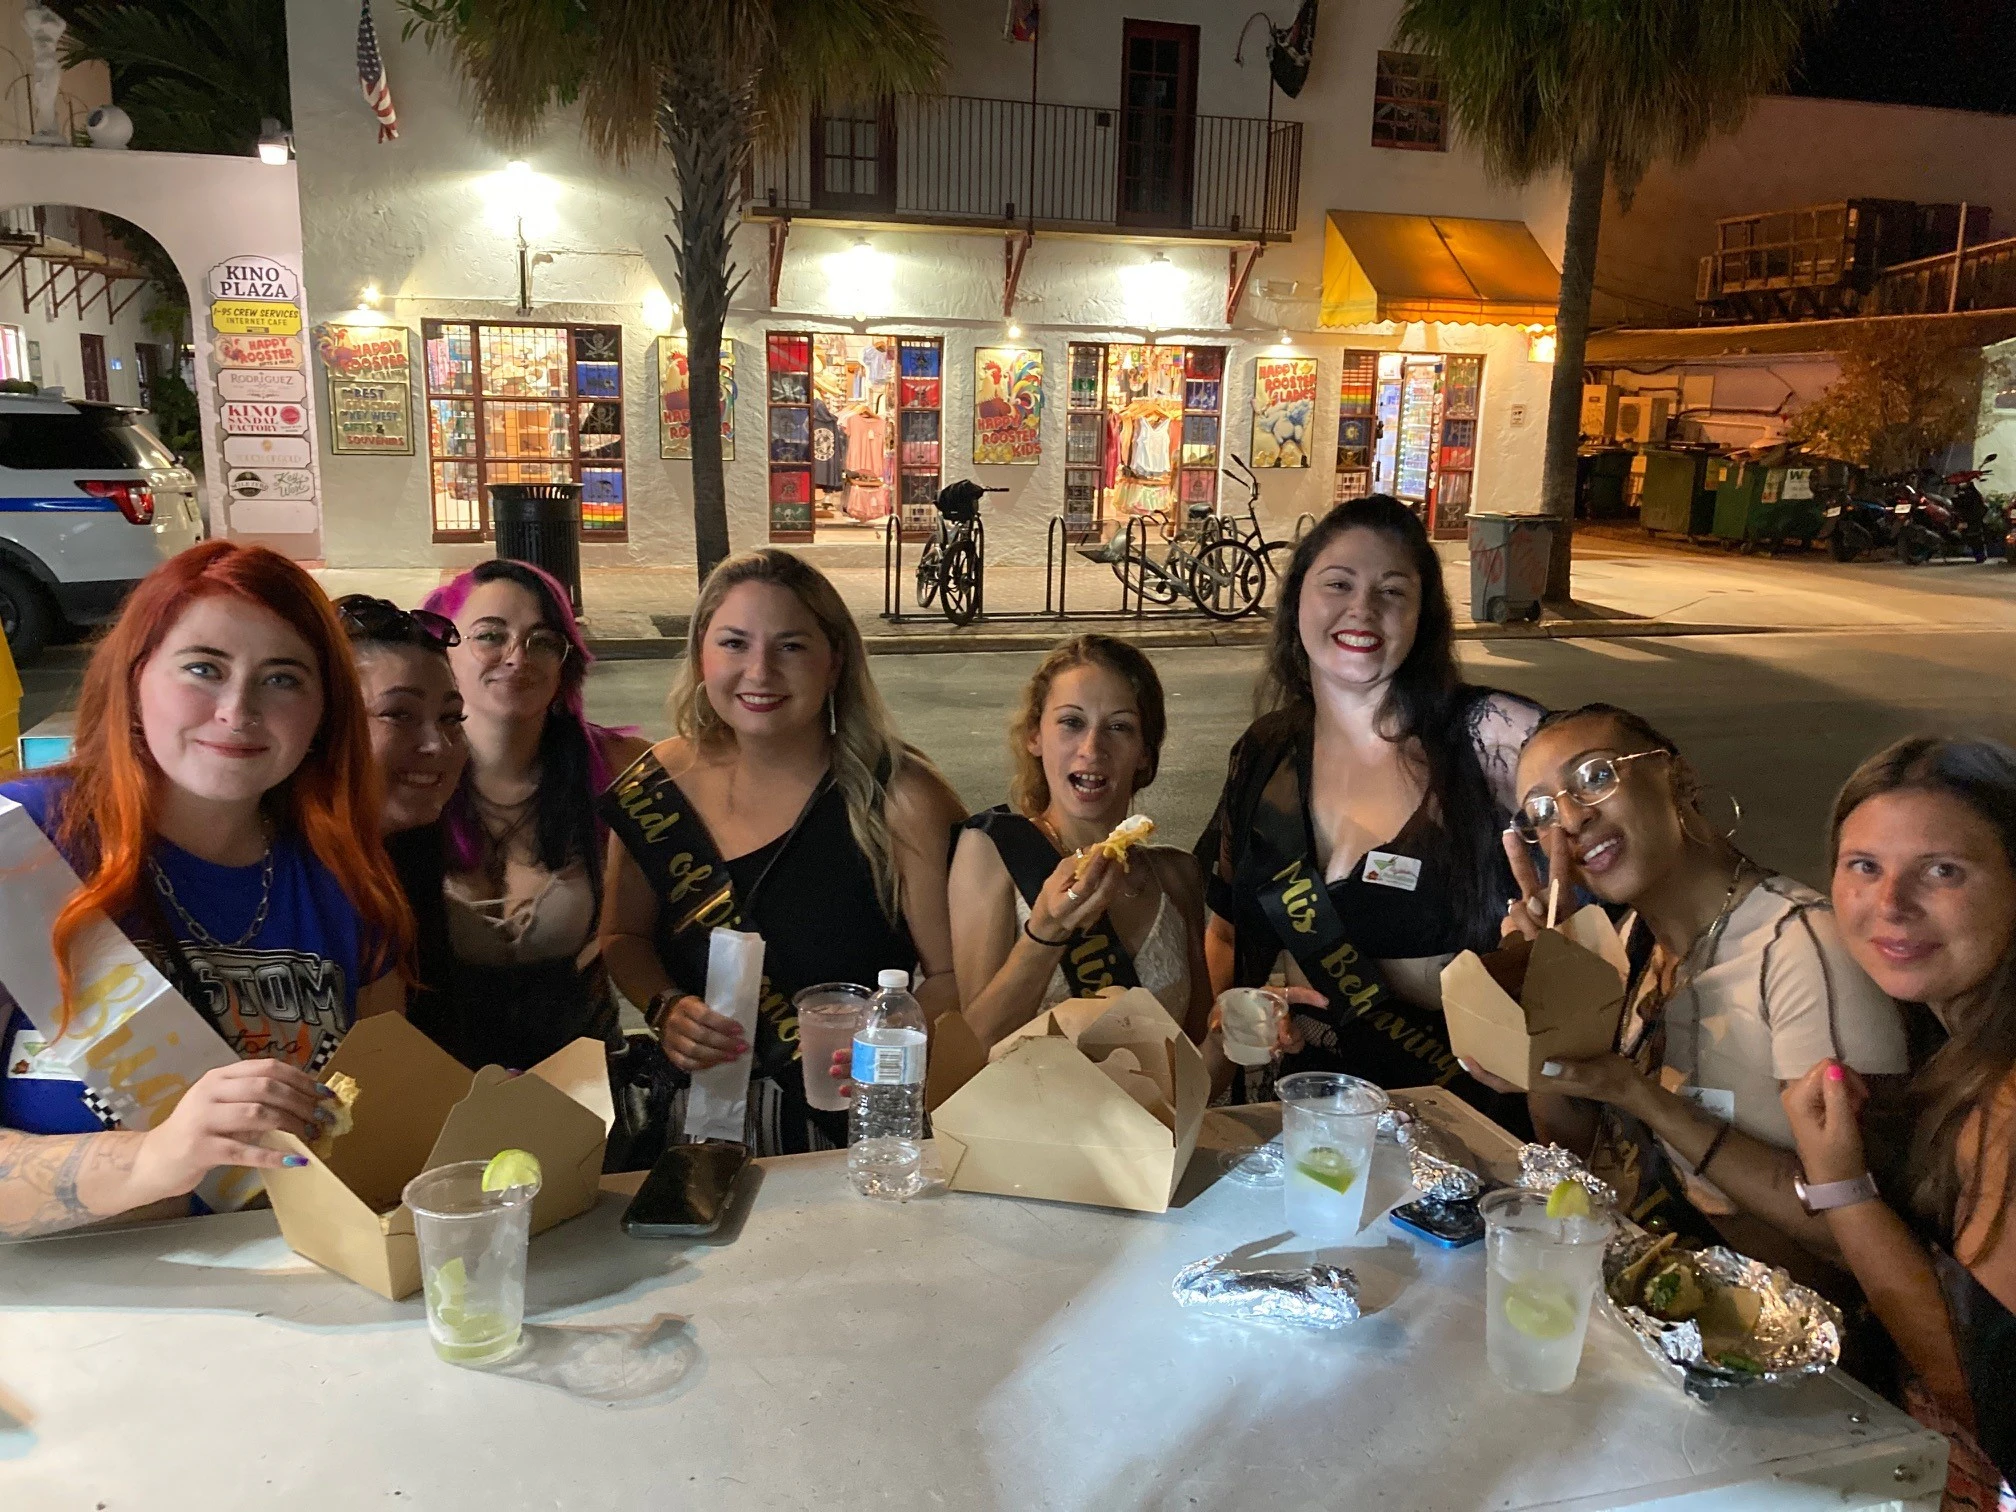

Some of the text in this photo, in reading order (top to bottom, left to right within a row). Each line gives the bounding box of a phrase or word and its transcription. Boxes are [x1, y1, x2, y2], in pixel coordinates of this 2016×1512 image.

[226, 265, 280, 282] KINO
[220, 281, 289, 298] PLAZA
[233, 308, 258, 317] CREW
[260, 309, 299, 318] SERVICES
[226, 317, 288, 326] INTERNET CAFE
[248, 337, 288, 351] HAPPY
[351, 338, 400, 356] HAPPY
[240, 348, 294, 364] ROOSTER
[341, 353, 408, 374] ROOSTER
[1258, 362, 1299, 380] HAPPY
[231, 373, 294, 385] RODRIGUEZ
[1265, 374, 1317, 393] ROOSTER
[354, 388, 386, 399] BEST
[228, 405, 278, 417] KINO
[349, 411, 367, 420] KEY
[371, 411, 398, 421] WEST
[342, 422, 385, 434] GIFTS &
[977, 414, 1021, 430] HAPPY
[346, 435, 405, 446] SOUVENIRS
[982, 428, 1039, 445] ROOSTER
[1012, 443, 1042, 457] KIDS
[669, 852, 713, 903] of
